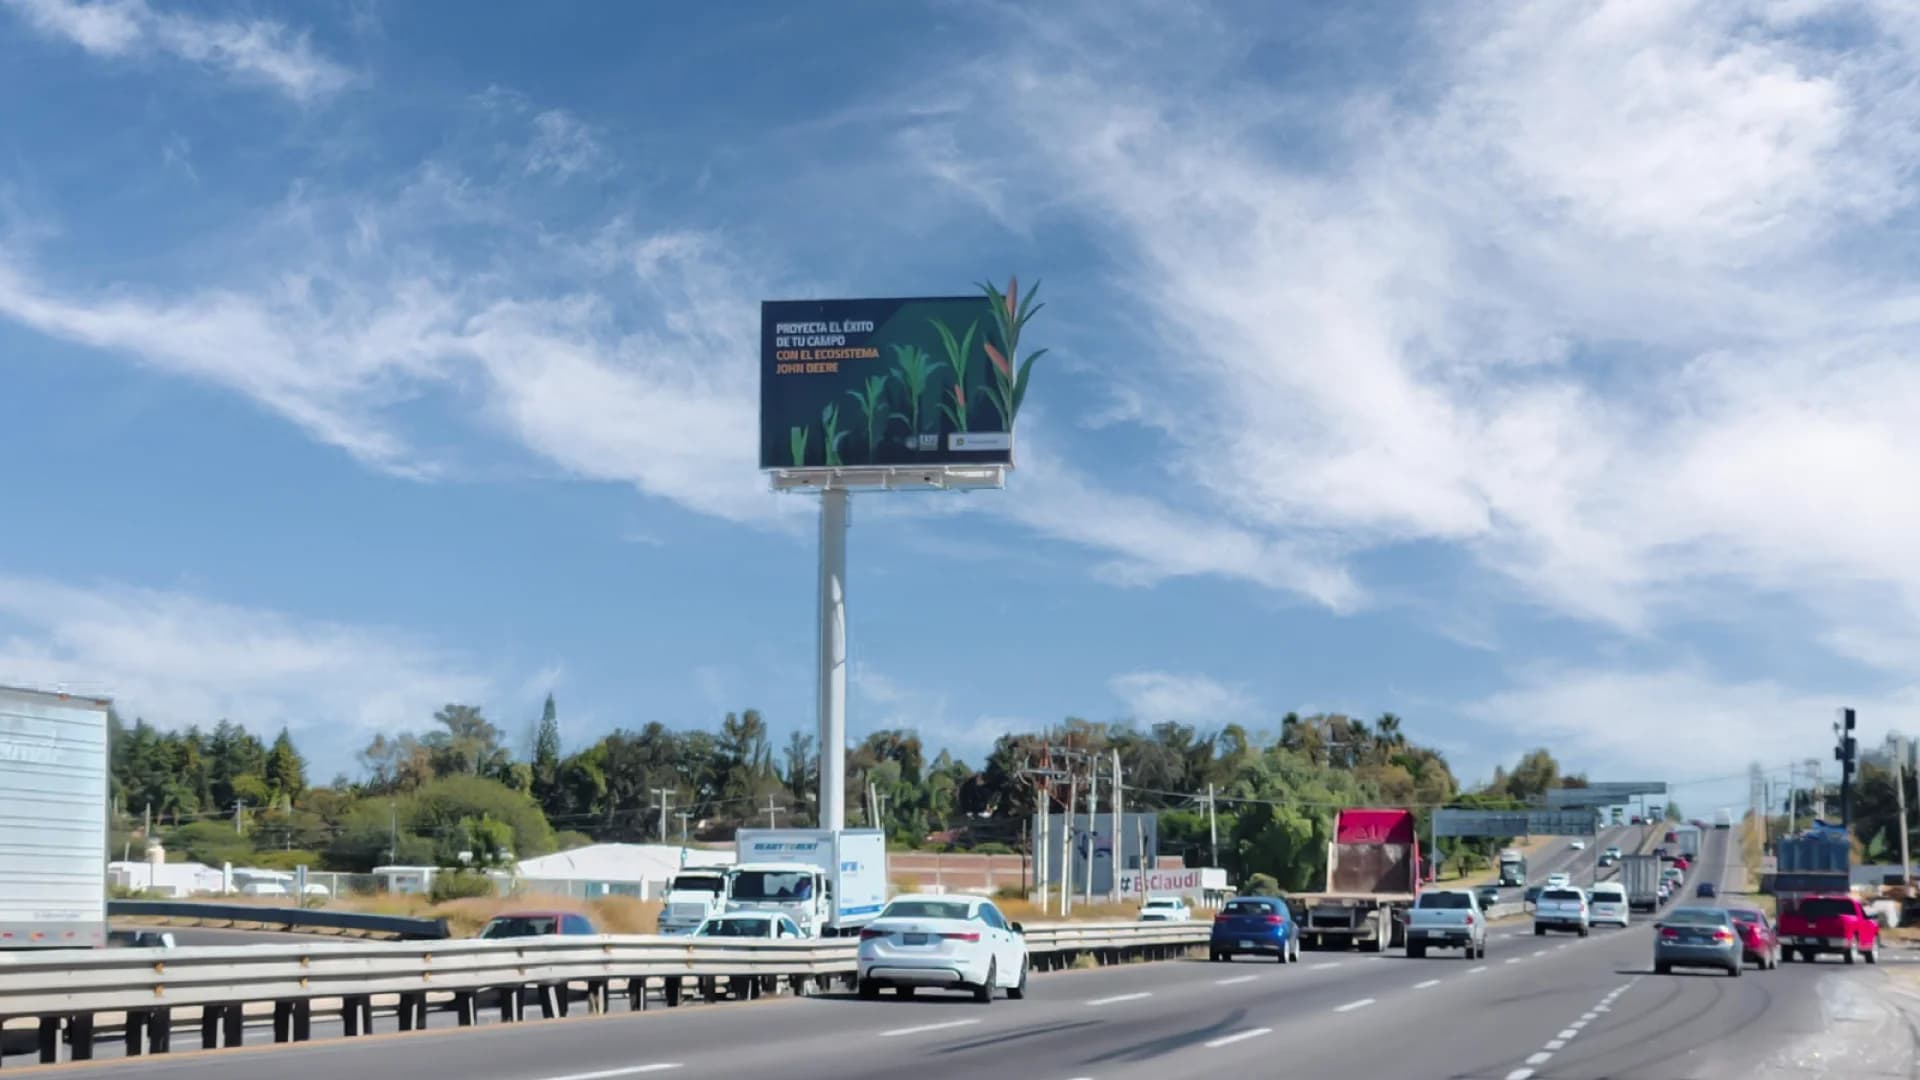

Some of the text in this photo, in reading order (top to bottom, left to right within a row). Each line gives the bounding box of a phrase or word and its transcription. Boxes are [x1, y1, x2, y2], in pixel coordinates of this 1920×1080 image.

[776, 319, 874, 334] PROYECTA EL ÉXITO
[776, 335, 846, 347] DE TU CAMPO
[776, 347, 880, 360] CON EL ECOSISTEMA
[776, 362, 839, 374] JOHN DEERE
